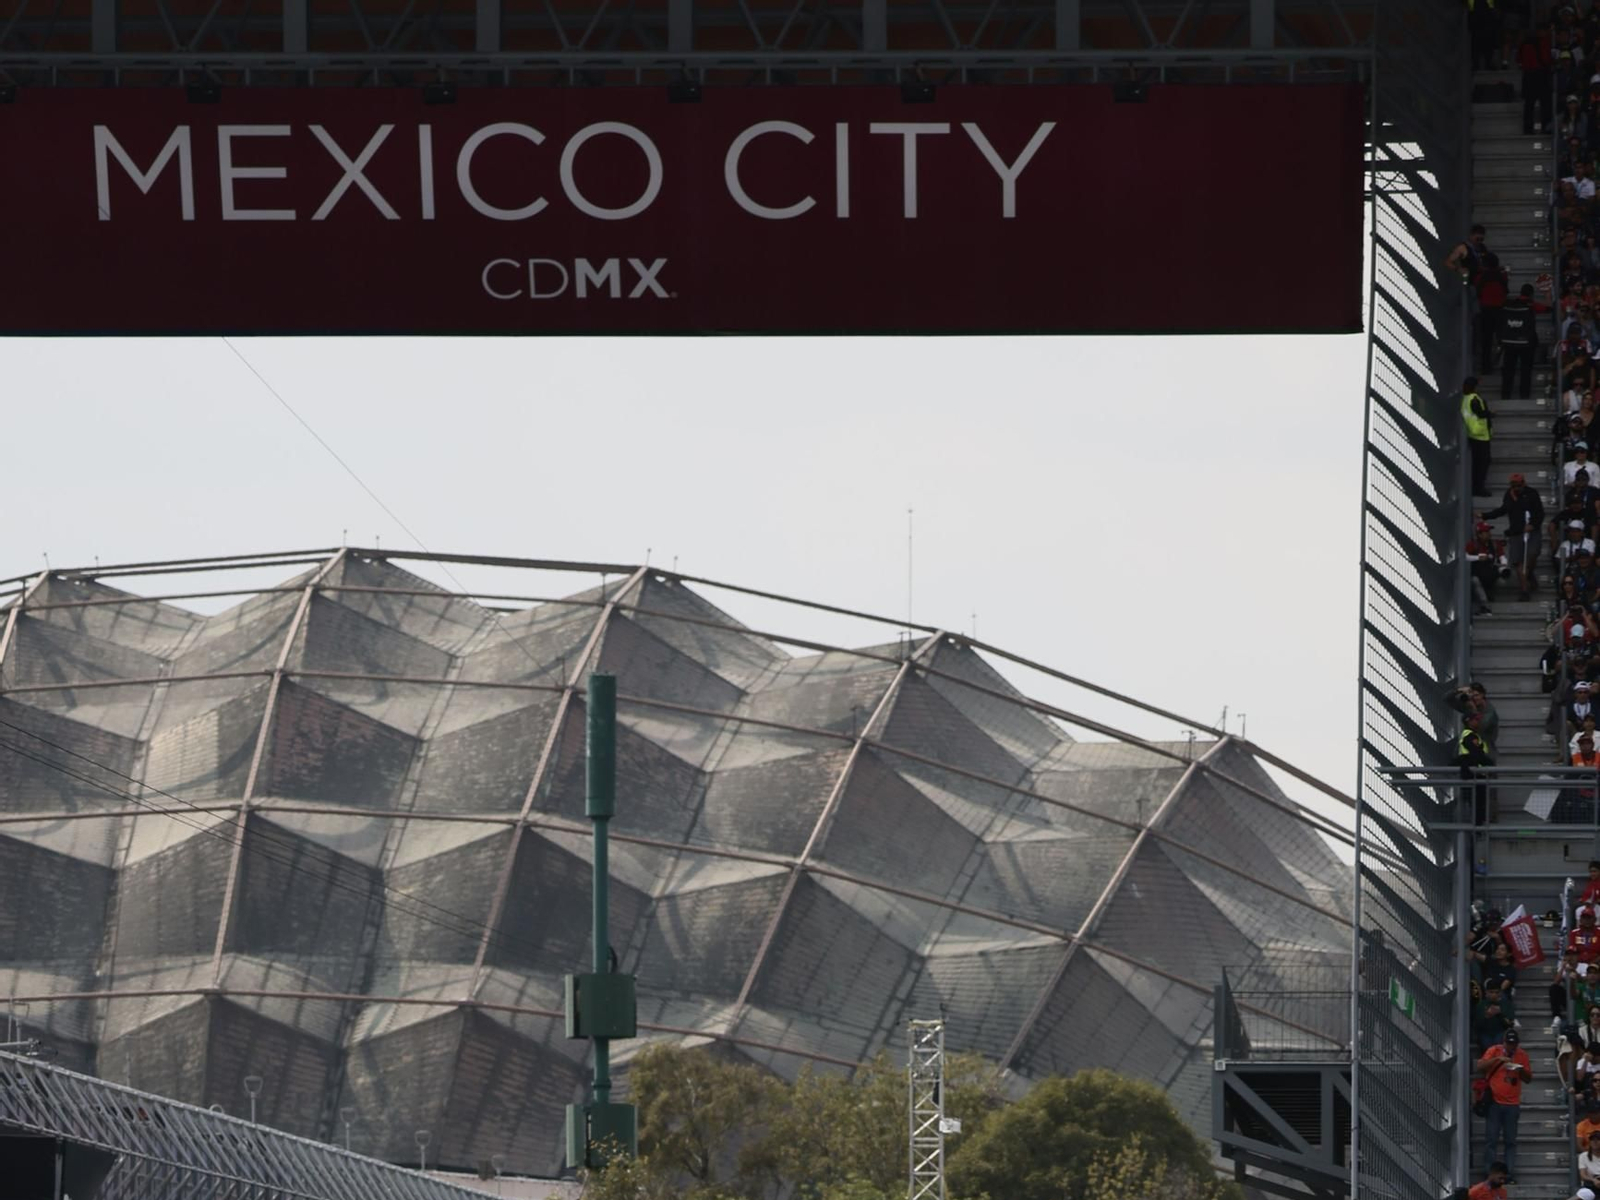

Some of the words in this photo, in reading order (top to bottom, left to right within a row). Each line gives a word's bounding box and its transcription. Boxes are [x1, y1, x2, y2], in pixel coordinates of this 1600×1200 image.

[92, 121, 663, 221] MEXICO
[724, 119, 1057, 220] CITY
[481, 258, 671, 300] CDMX
